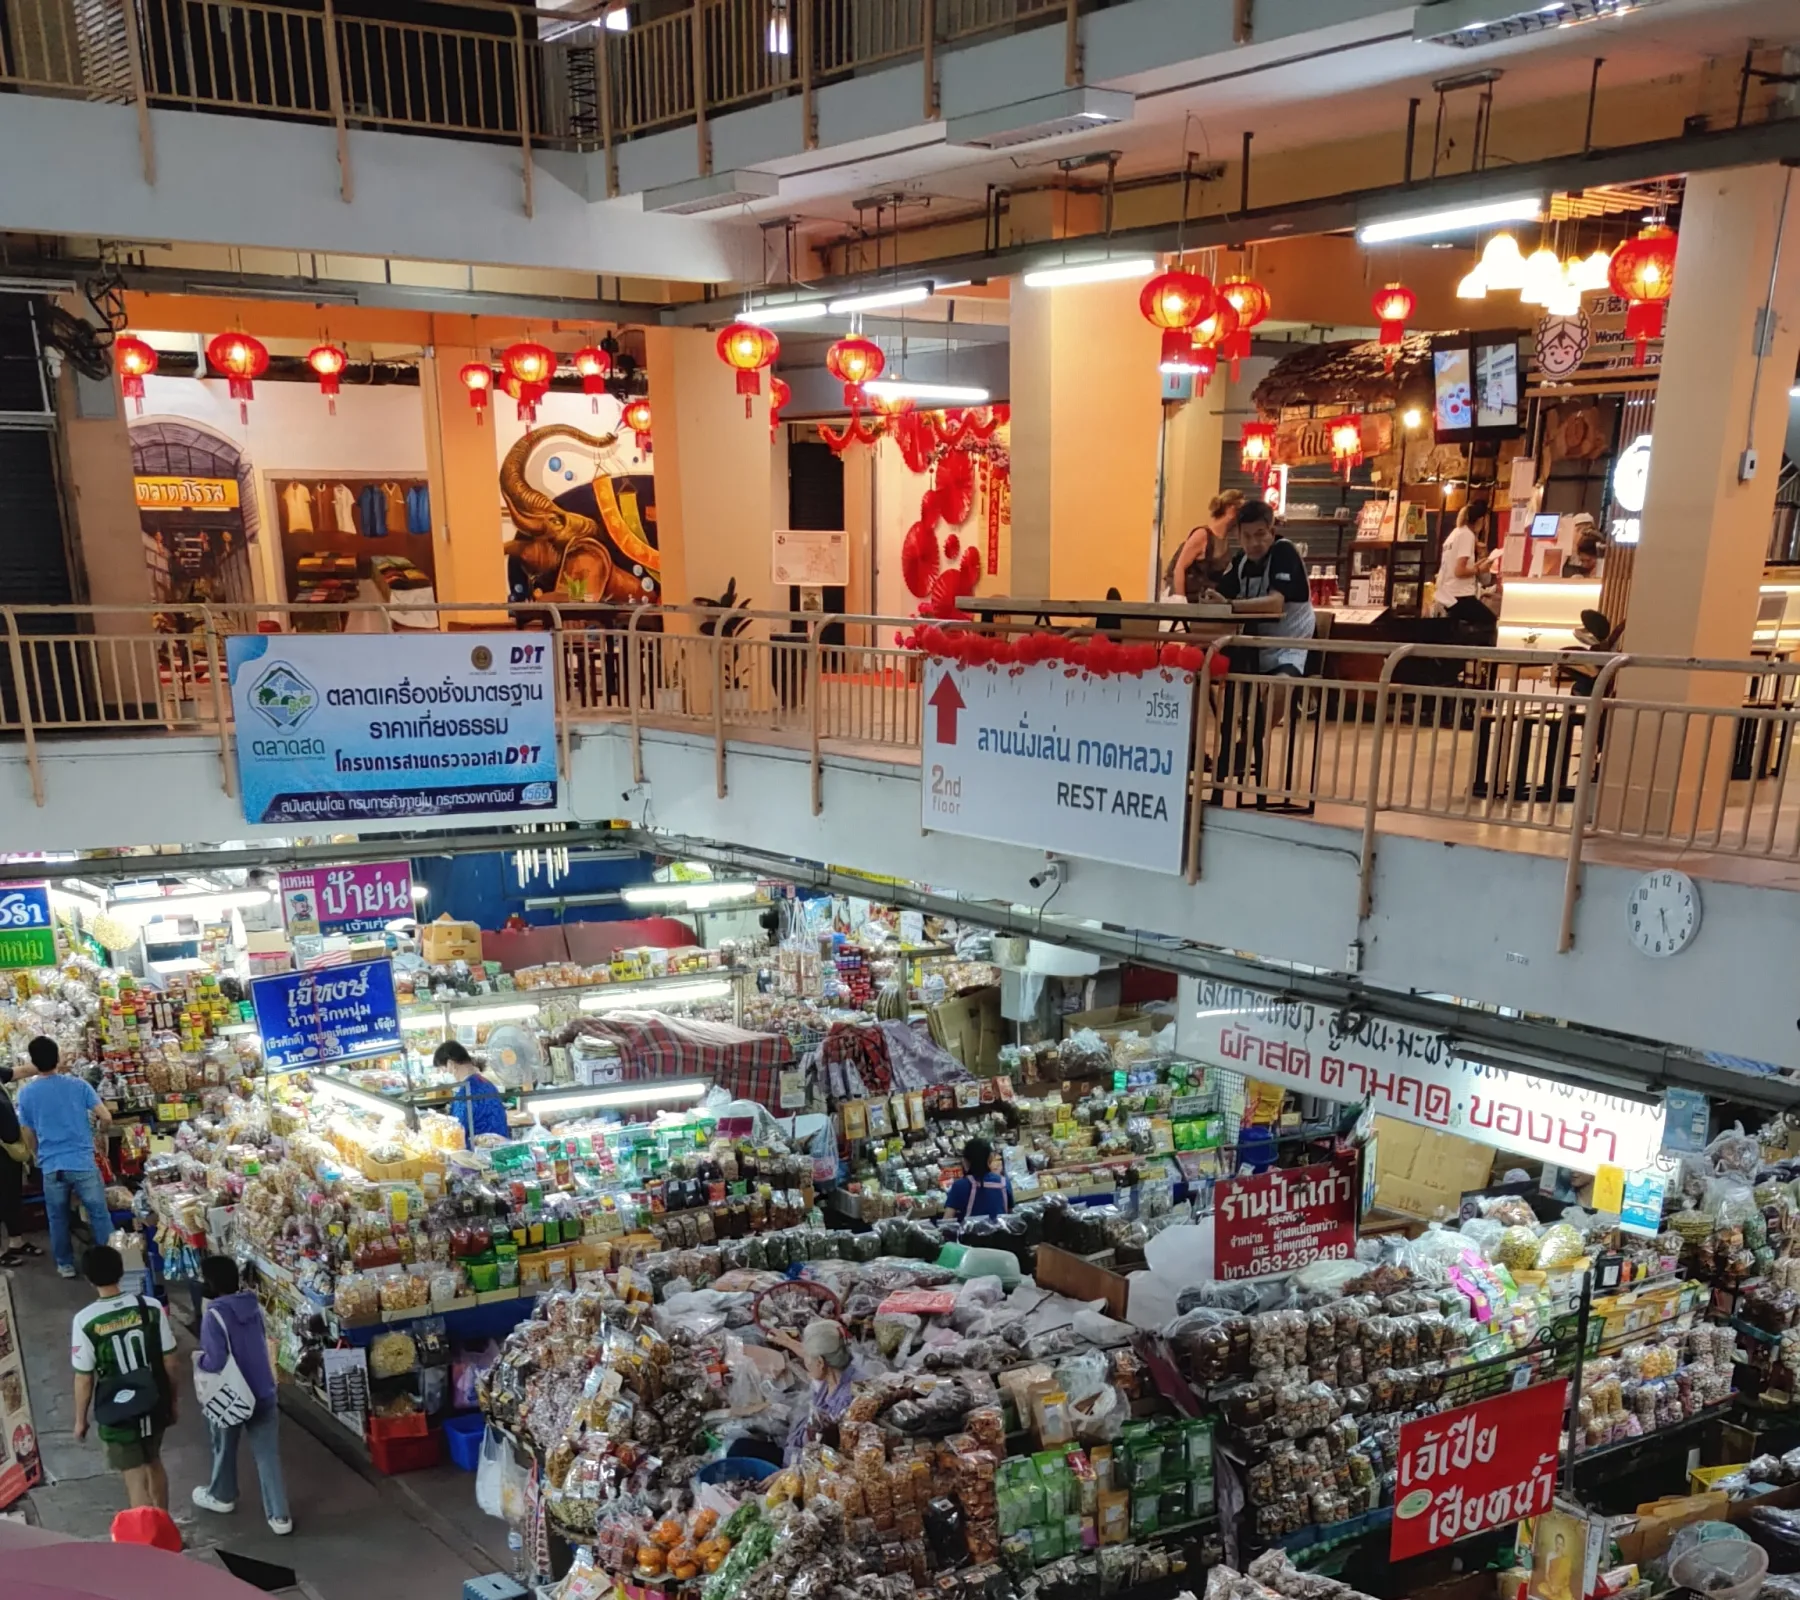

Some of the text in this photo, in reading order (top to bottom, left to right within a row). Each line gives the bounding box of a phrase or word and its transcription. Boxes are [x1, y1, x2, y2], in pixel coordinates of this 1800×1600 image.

[326, 676, 543, 707] ตลาดเครื่องชั่งมาตรฐาน
[1146, 692, 1179, 719] วโรรส
[369, 710, 509, 739] ราคาเที่ยงธรรม
[252, 737, 325, 756] ตลาดสด
[978, 711, 1173, 776] ลานนั่งเล่น กาดหลวง
[931, 764, 962, 797] 2nd
[281, 797, 345, 815] สนับสนุนโดย
[932, 797, 961, 815] floor
[1057, 781, 1169, 822] REST AREA
[1650, 877, 1657, 889] 11
[1662, 874, 1672, 887] 12
[1677, 882, 1682, 893] 1
[322, 870, 409, 914] ป้าย่น
[1639, 888, 1648, 900] 10
[1632, 903, 1638, 914] 9
[1684, 895, 1690, 906] 2
[345, 917, 391, 932] เจ้าเก่
[1634, 920, 1641, 932] 8
[1687, 913, 1692, 924] 3
[1643, 933, 1648, 946] 7
[1679, 929, 1685, 940] 4
[1655, 941, 1661, 952] 6
[1668, 939, 1674, 951] 5
[288, 1001, 371, 1028] น้ำพริกหนุ่ม
[1219, 1022, 1311, 1079] ผักสด
[1320, 1055, 1451, 1126] ตามฤดู
[1470, 1094, 1617, 1162] ของชำ
[1220, 1167, 1350, 1221] ร้านป้าแก้ว
